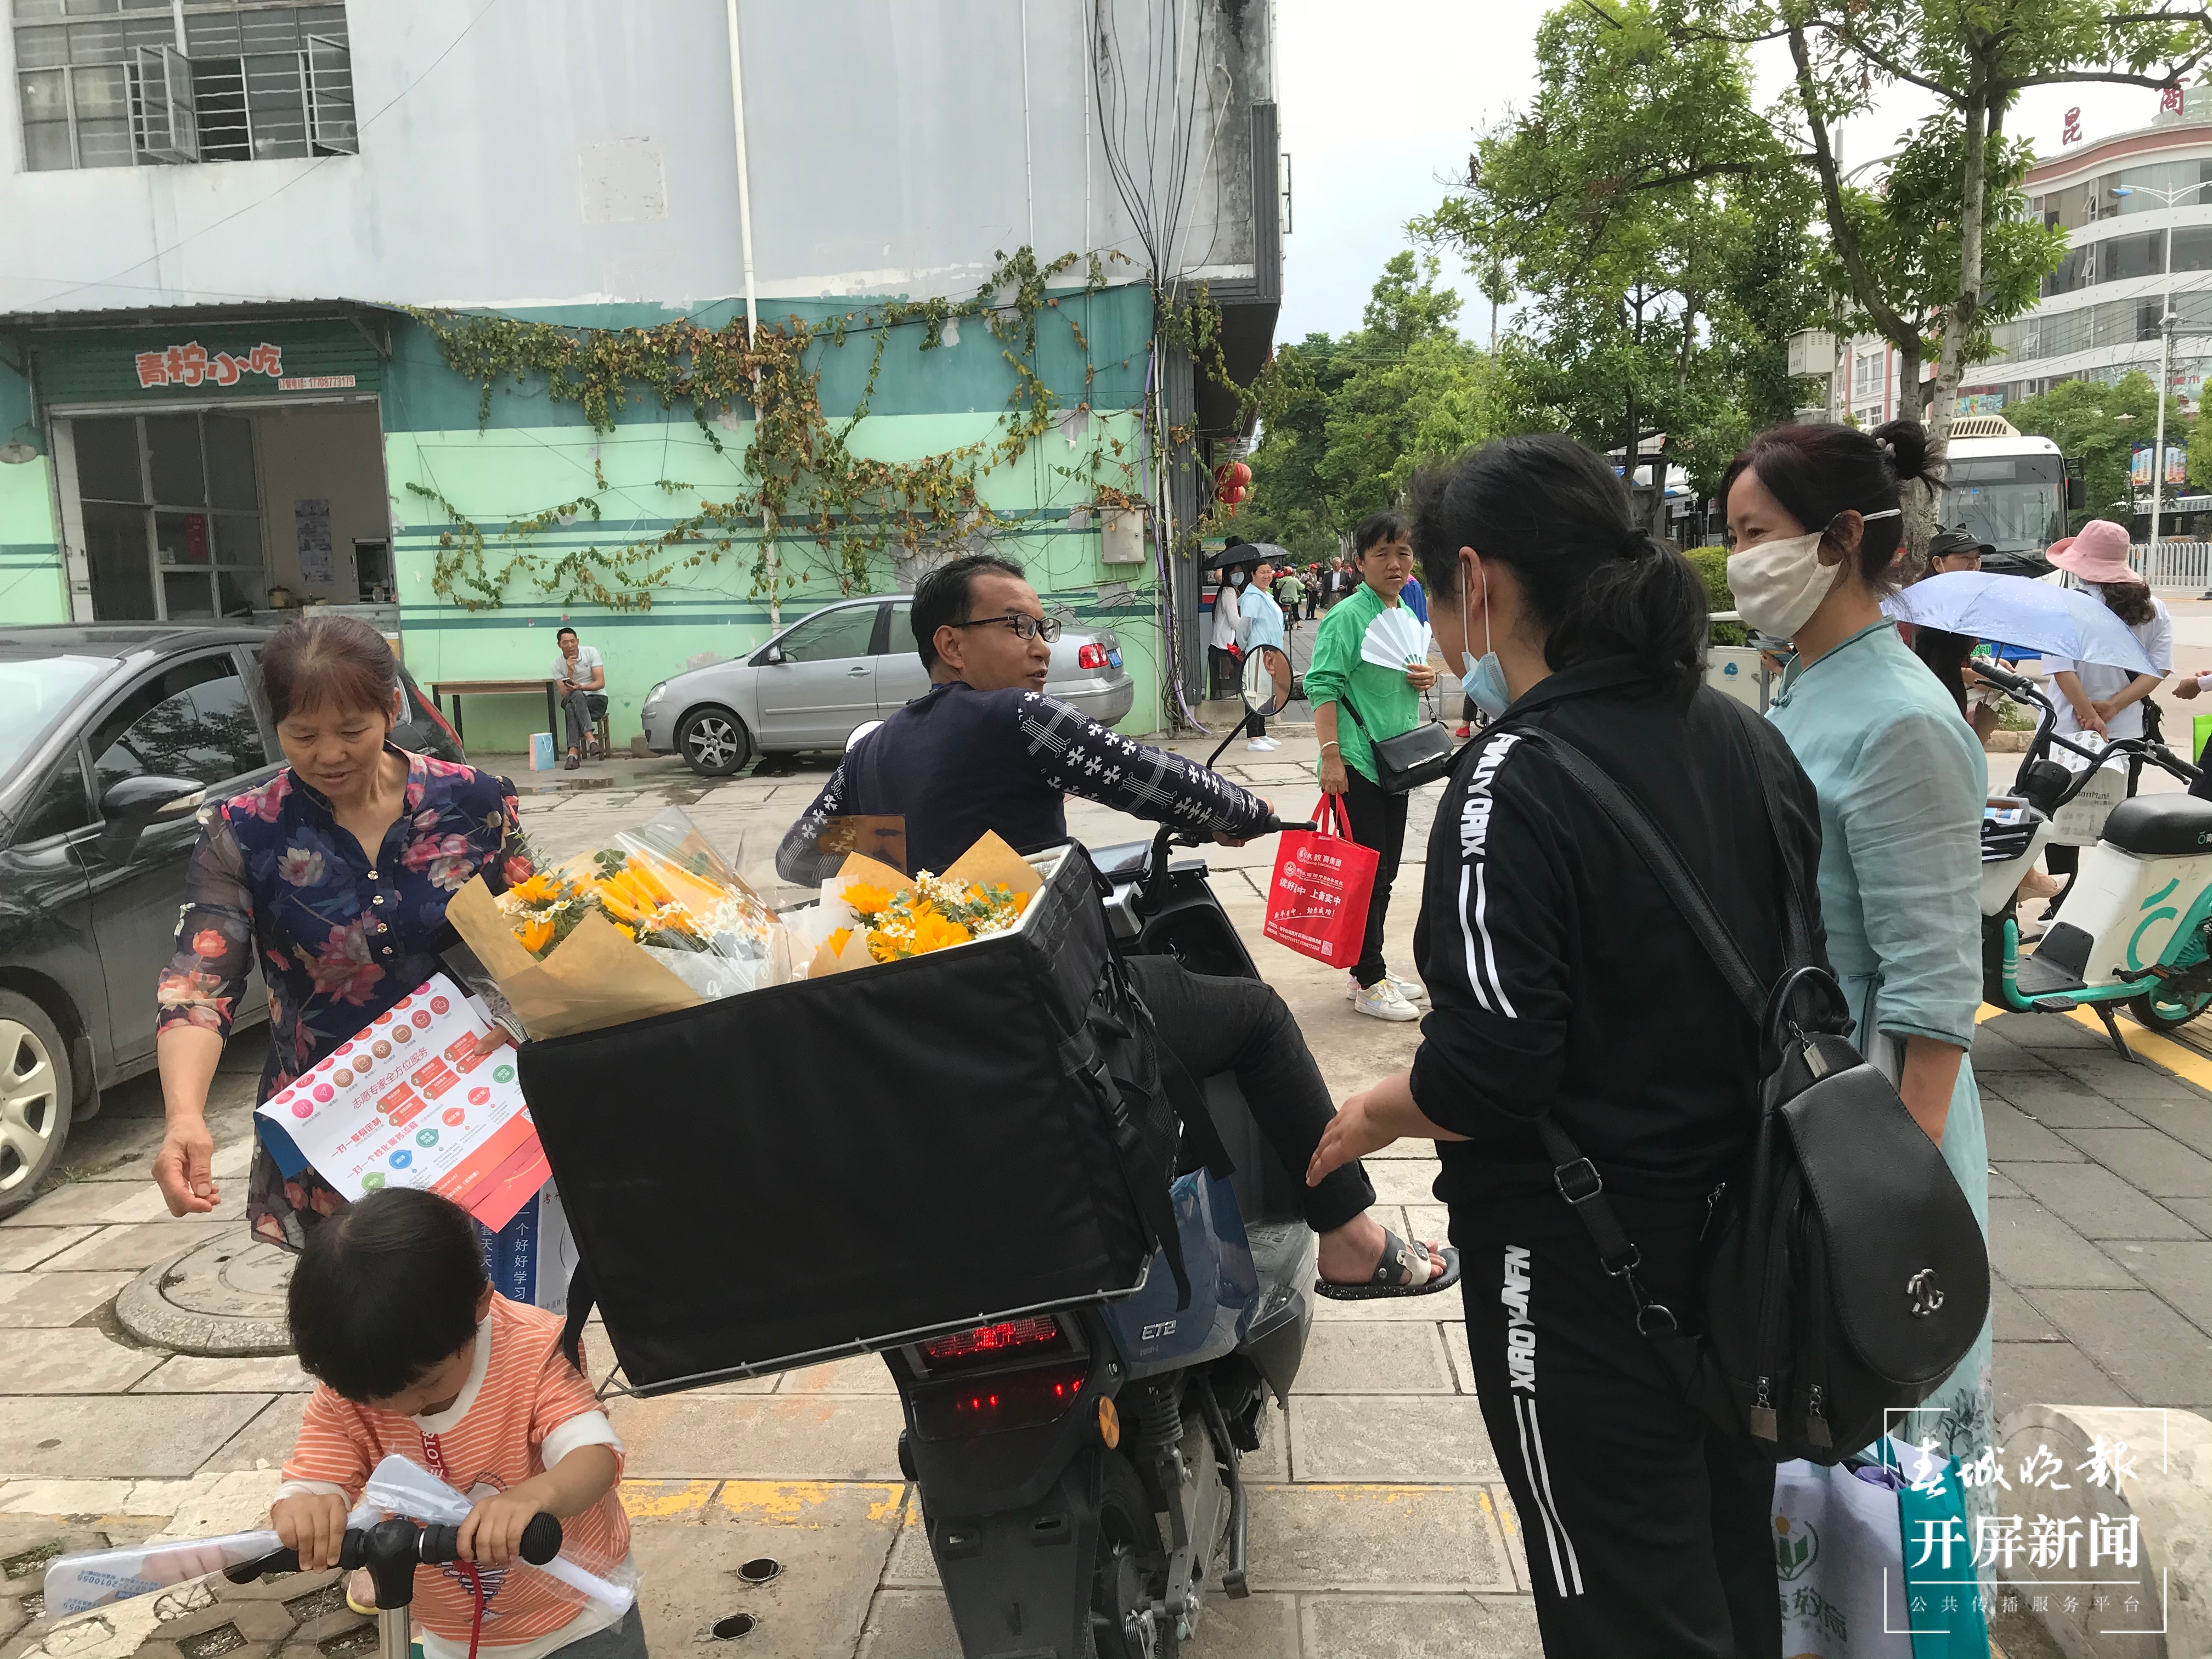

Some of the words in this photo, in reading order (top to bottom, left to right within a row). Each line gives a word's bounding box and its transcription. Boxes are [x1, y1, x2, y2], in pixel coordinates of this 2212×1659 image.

[2062, 107, 2082, 145] 昆
[136, 341, 283, 388] 青柠小吃
[351, 1047, 428, 1109] 志愿专家全方位服务
[331, 1117, 382, 1157] 一对一量身定制
[347, 1121, 419, 1178] 一对一个性化服务流程
[1141, 1319, 1177, 1340] ET2
